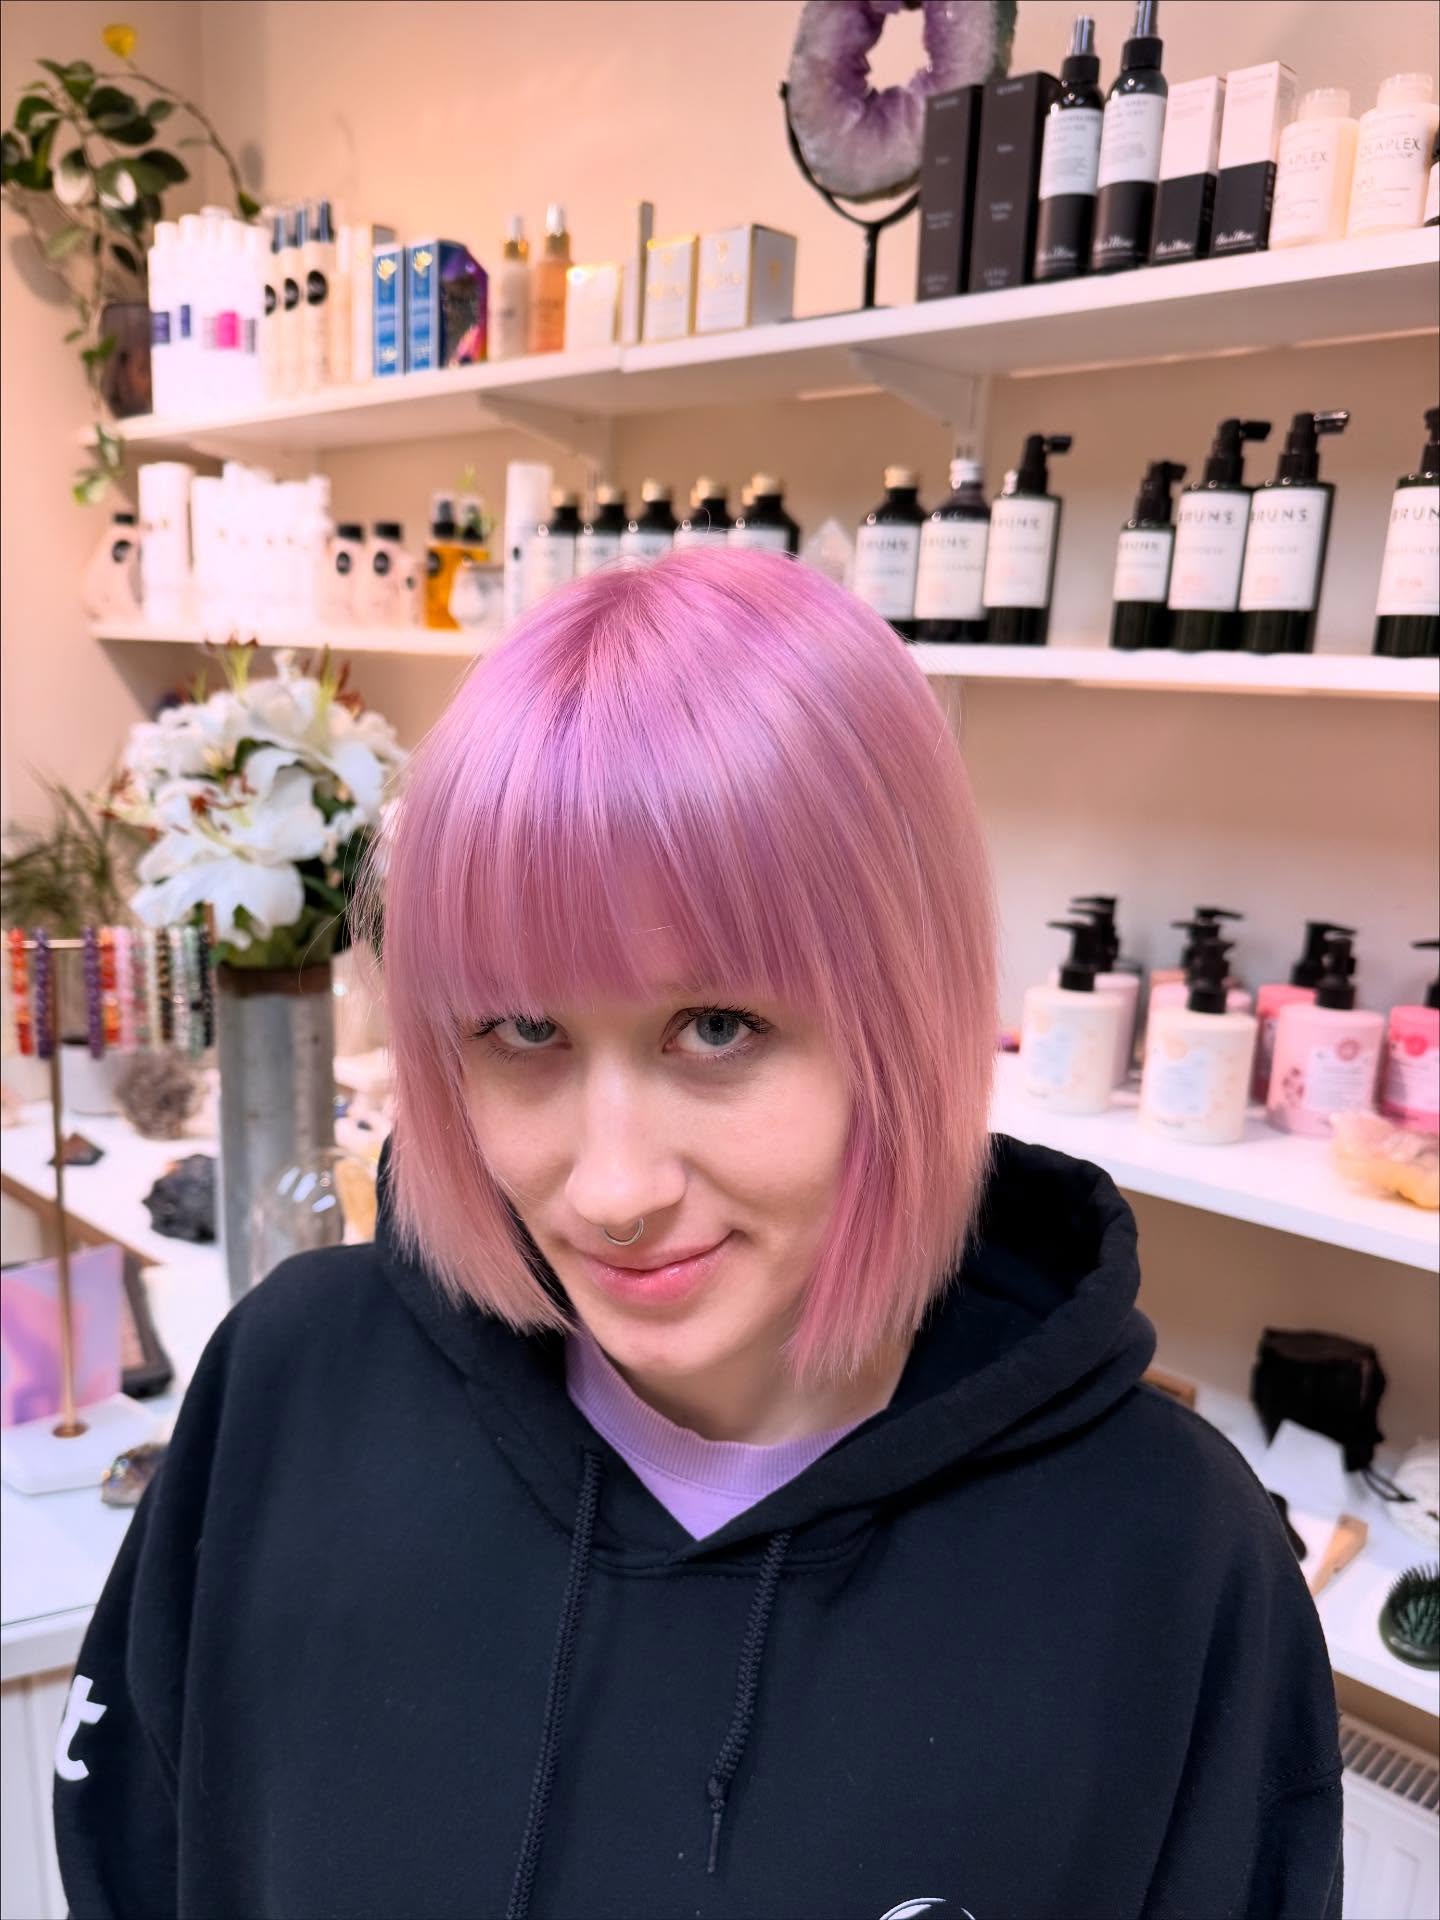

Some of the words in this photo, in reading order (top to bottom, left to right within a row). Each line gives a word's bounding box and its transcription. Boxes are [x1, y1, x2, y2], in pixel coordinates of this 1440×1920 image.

[1175, 507, 1235, 524] BRUNS
[1249, 506, 1311, 522] BRUNS
[1391, 506, 1439, 522] BRUN
[54, 1674, 108, 1782] t
